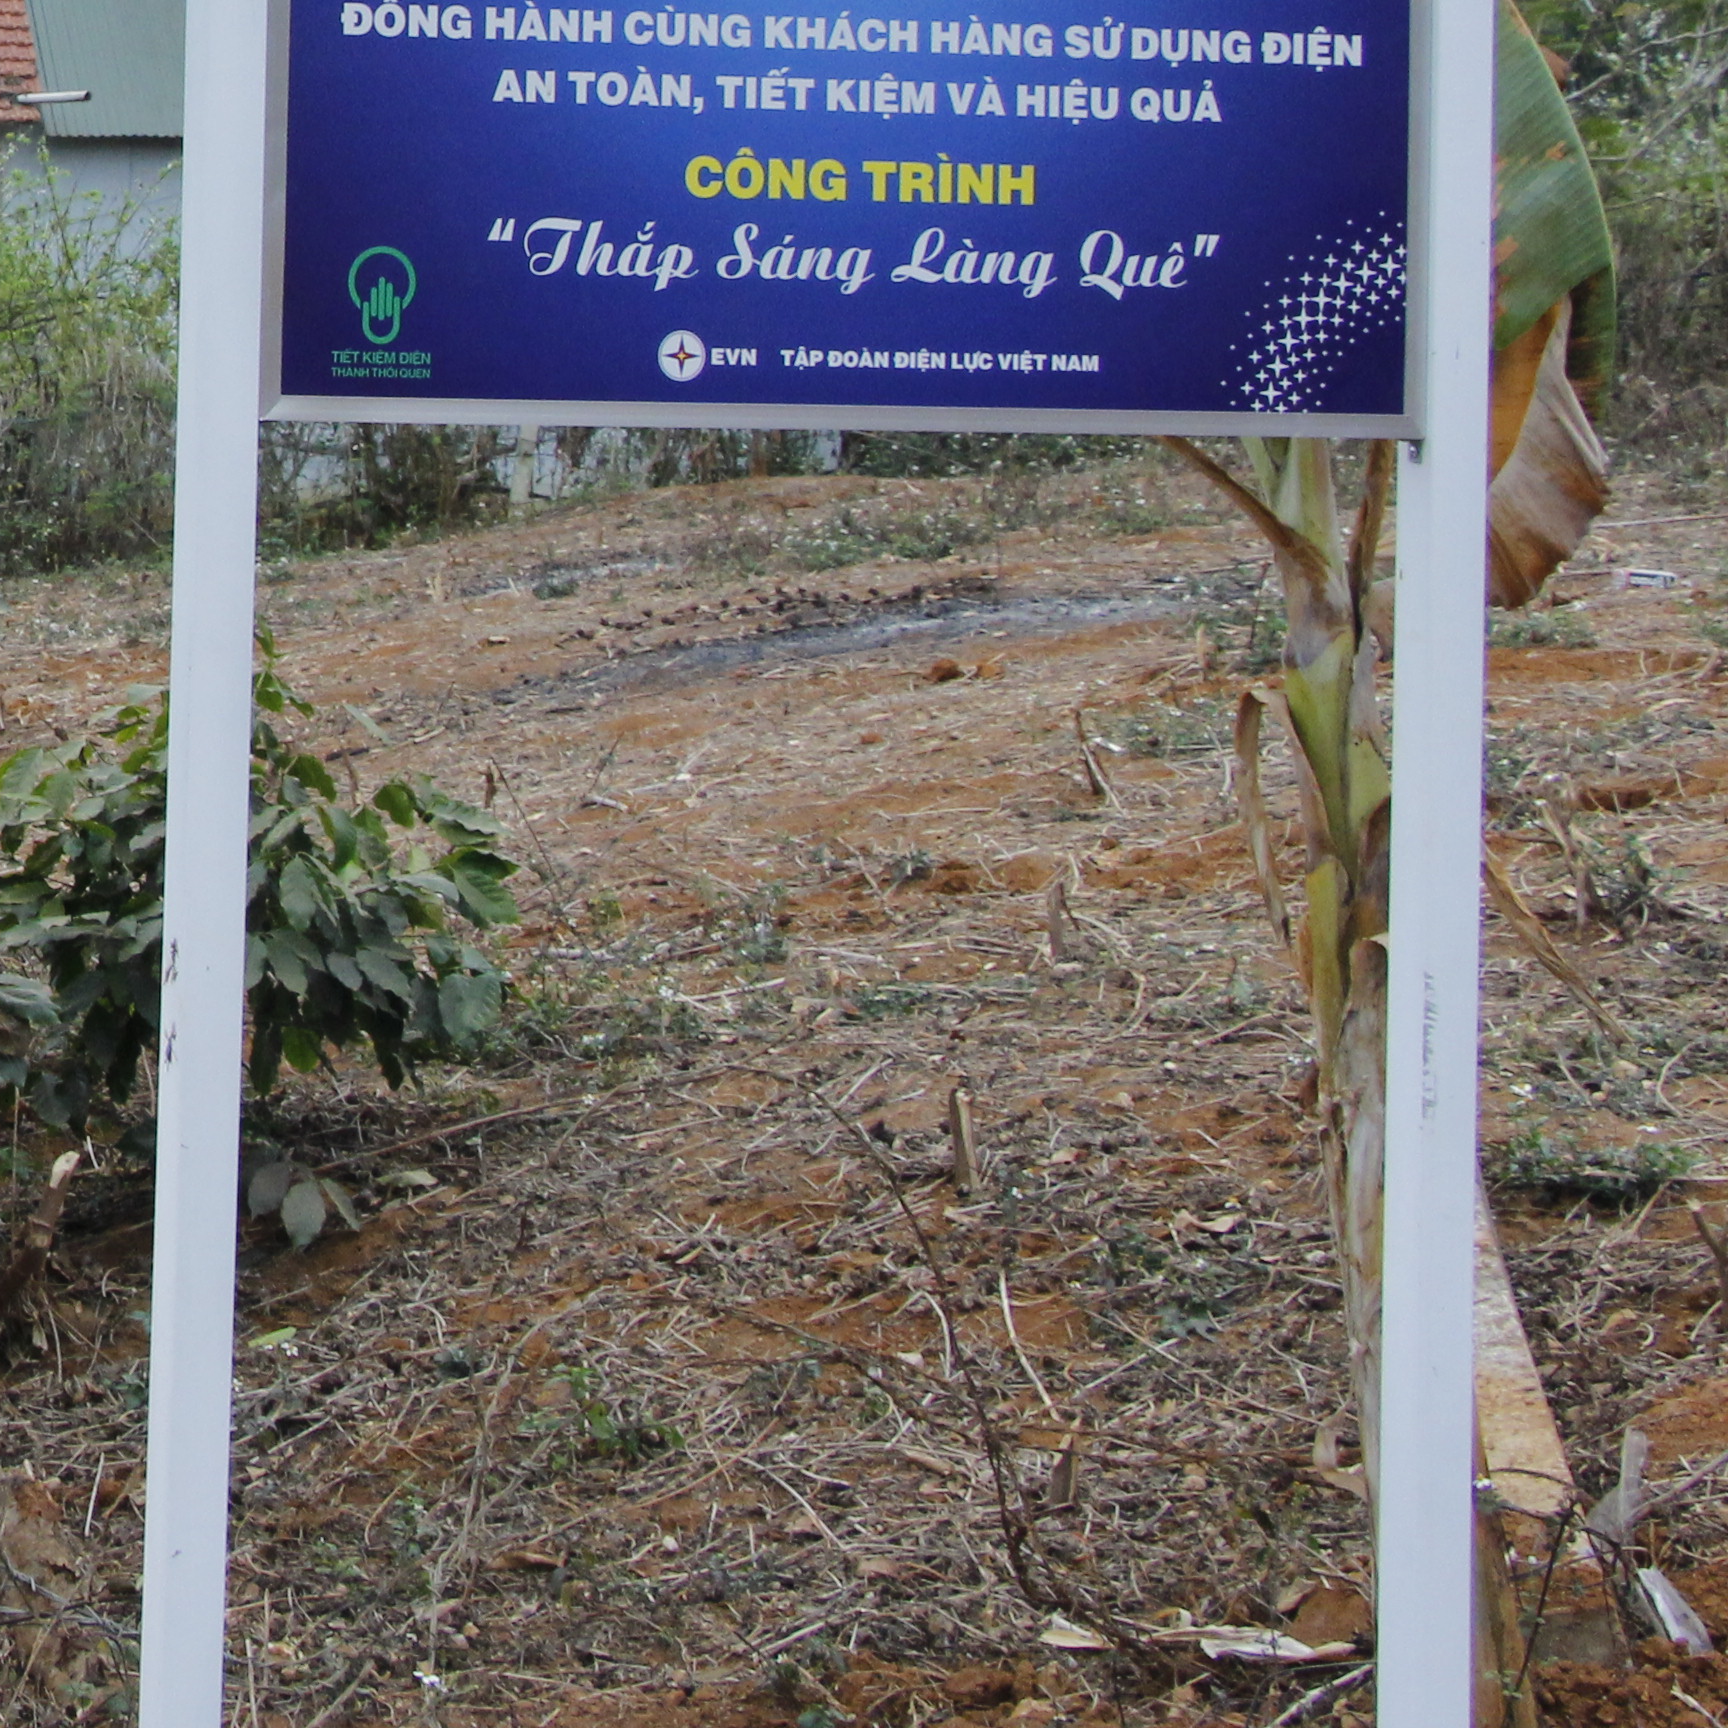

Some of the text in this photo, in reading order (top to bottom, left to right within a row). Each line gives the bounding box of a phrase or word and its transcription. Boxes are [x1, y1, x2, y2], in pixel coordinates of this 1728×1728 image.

[485, 0, 613, 43] HÀNH
[624, 6, 751, 47] CÙNG
[764, 11, 918, 53] KHÁCH
[930, 15, 1053, 57] HÀNG
[1064, 17, 1125, 60] SỬ
[1132, 27, 1252, 68] DỤNG
[1261, 26, 1363, 72] ĐIỆN
[493, 66, 1223, 126] AN TOÀN, TIẾT KIỆM VÀ HIỆU QUẢ
[685, 147, 1035, 206] CÔNG TRÌNH
[716, 223, 876, 295] Sáng
[890, 227, 1058, 299] Làng
[710, 348, 757, 366] EVN
[780, 346, 1100, 374] TẬP ĐOÀN ĐIỆN LỰC VIỆT NAM
